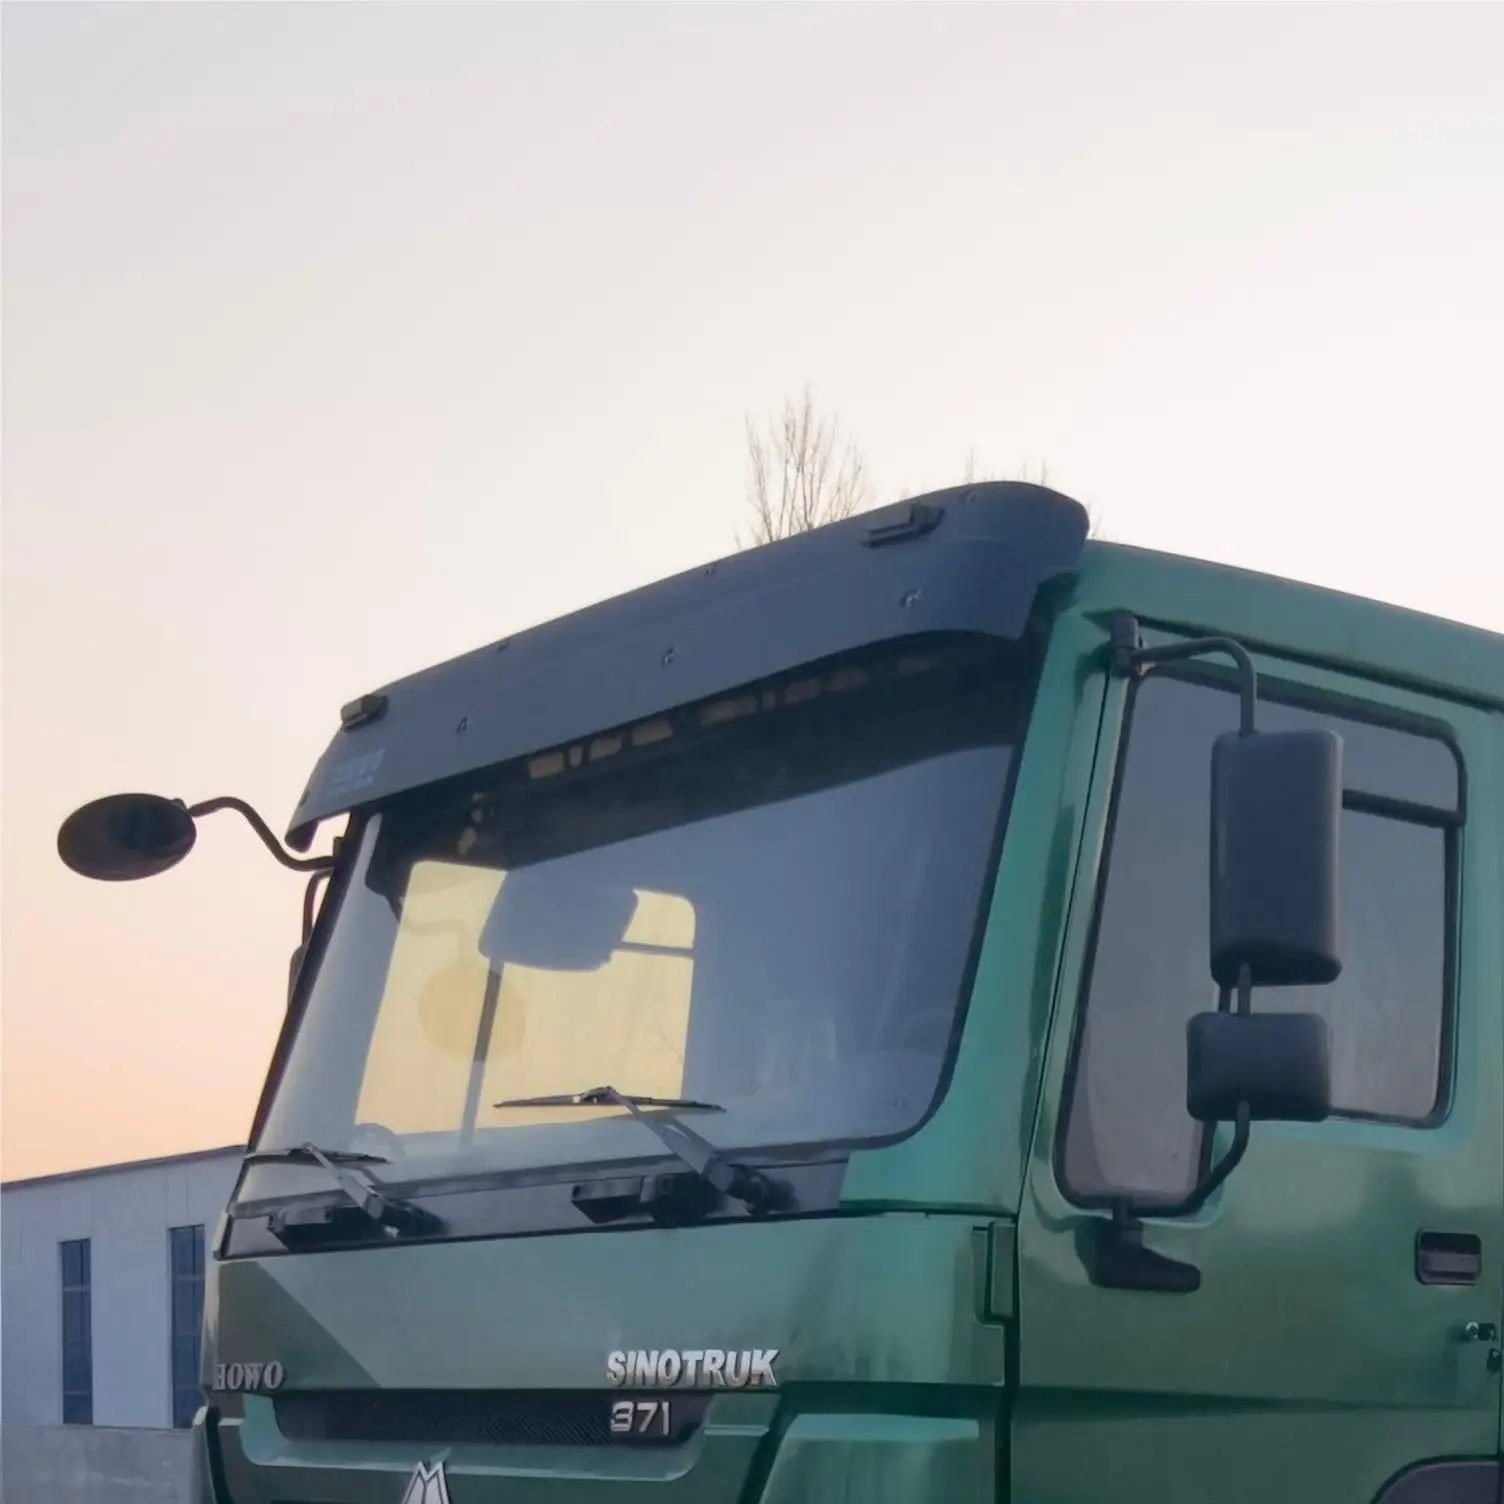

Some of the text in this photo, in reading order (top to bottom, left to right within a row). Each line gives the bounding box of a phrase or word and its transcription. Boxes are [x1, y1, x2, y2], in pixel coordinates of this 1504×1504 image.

[211, 1359, 285, 1391] HOWO
[606, 1348, 780, 1388] SINOTRUK
[609, 1399, 671, 1437] 371
